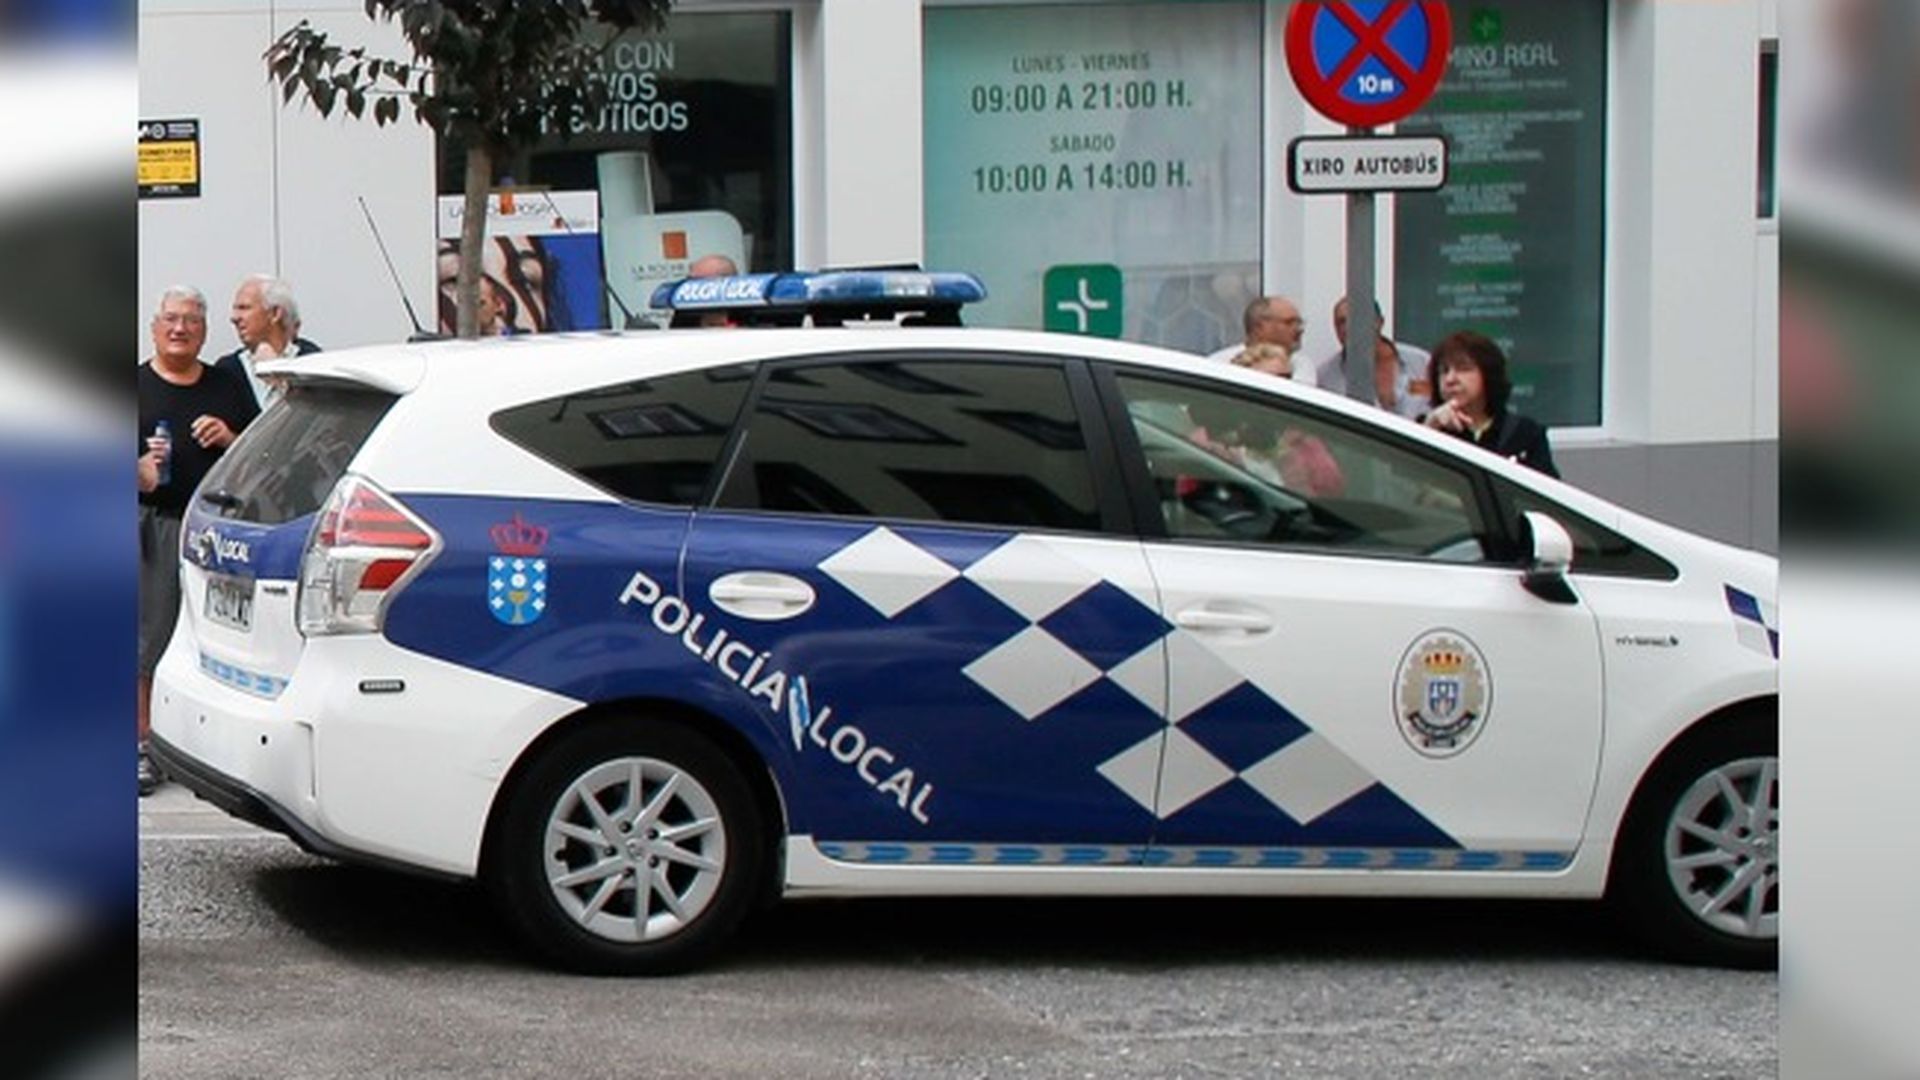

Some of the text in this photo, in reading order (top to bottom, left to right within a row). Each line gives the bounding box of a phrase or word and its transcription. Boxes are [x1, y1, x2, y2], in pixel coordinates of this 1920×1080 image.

[615, 43, 674, 70] CON
[1012, 56, 1065, 73] LUNES
[1080, 53, 1150, 71] VIERNES
[971, 79, 1192, 112] 09:00 A 21:00 H.
[1050, 133, 1115, 152] SABADO
[974, 160, 1192, 192] 10:00 A 14:00 H.
[1303, 157, 1344, 175] XIRO
[1354, 152, 1438, 175] AUTOBÚS
[619, 572, 933, 824] POLICÍA LOCAL
